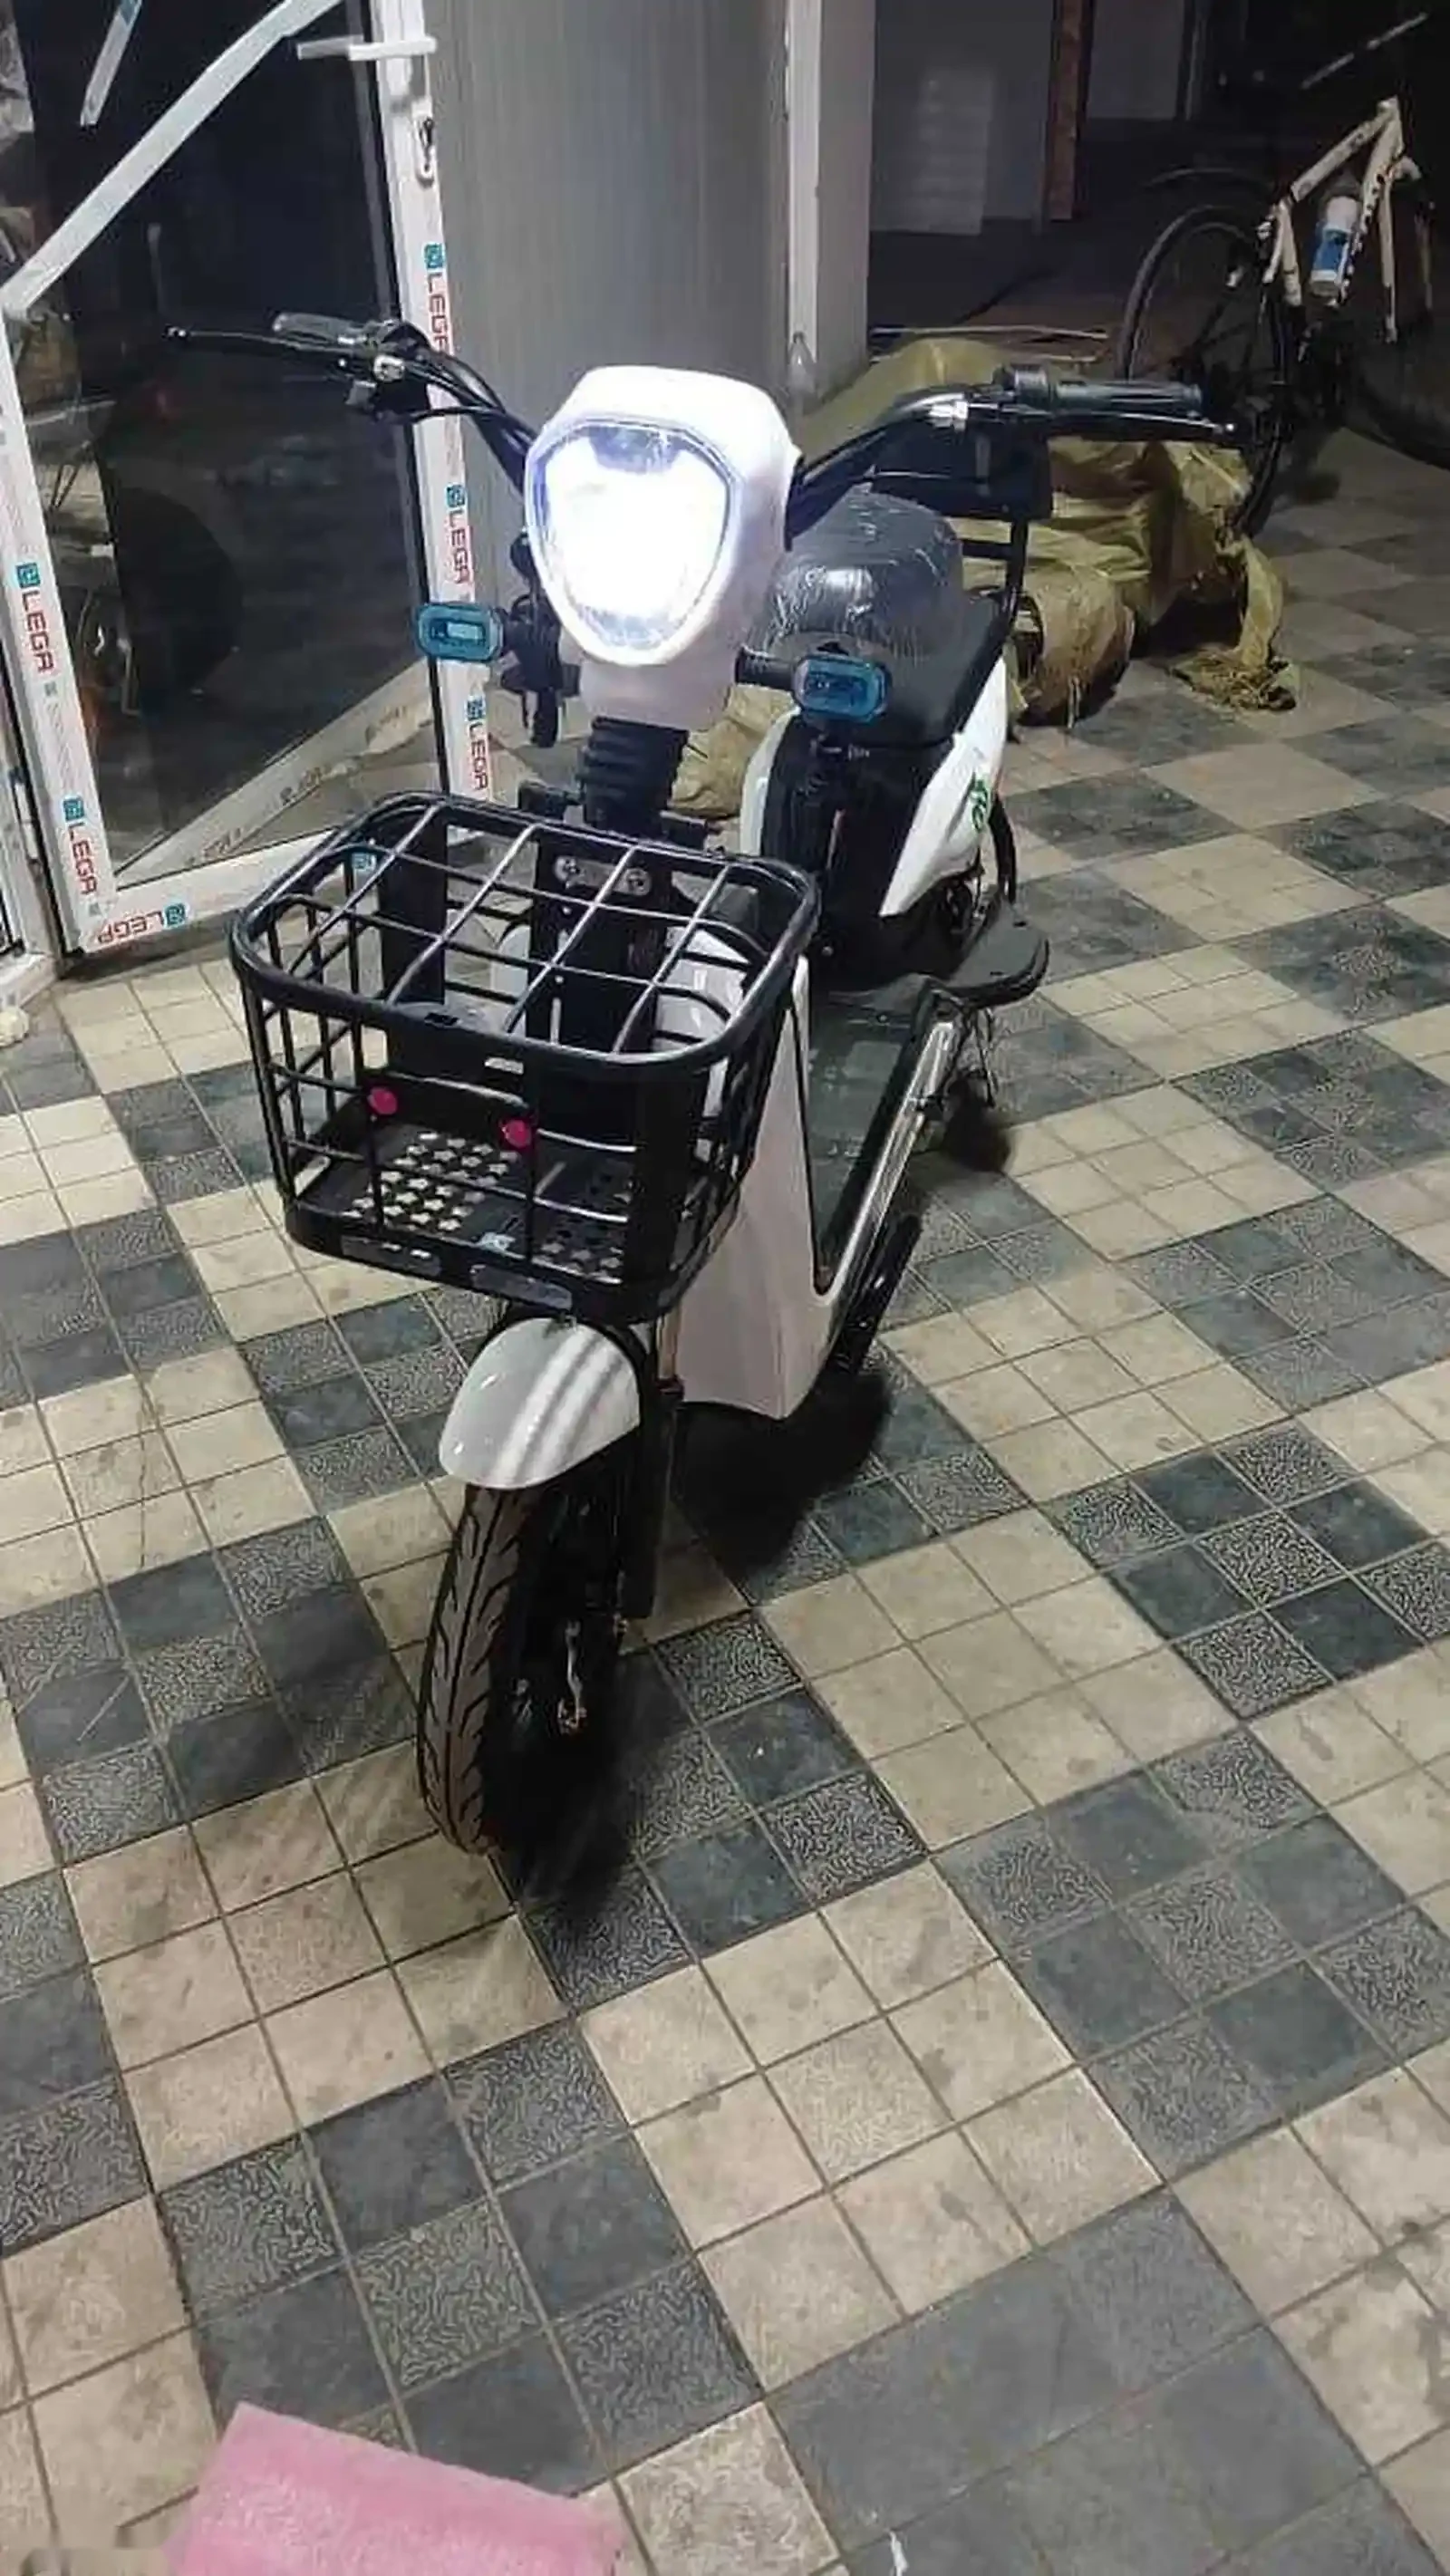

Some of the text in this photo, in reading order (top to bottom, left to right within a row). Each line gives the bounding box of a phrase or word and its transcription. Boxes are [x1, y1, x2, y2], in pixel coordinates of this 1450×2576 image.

[449, 509, 470, 584] LEGA
[22, 590, 54, 672] LEGA
[469, 722, 488, 791] LEGA
[68, 822, 97, 895] LEGA
